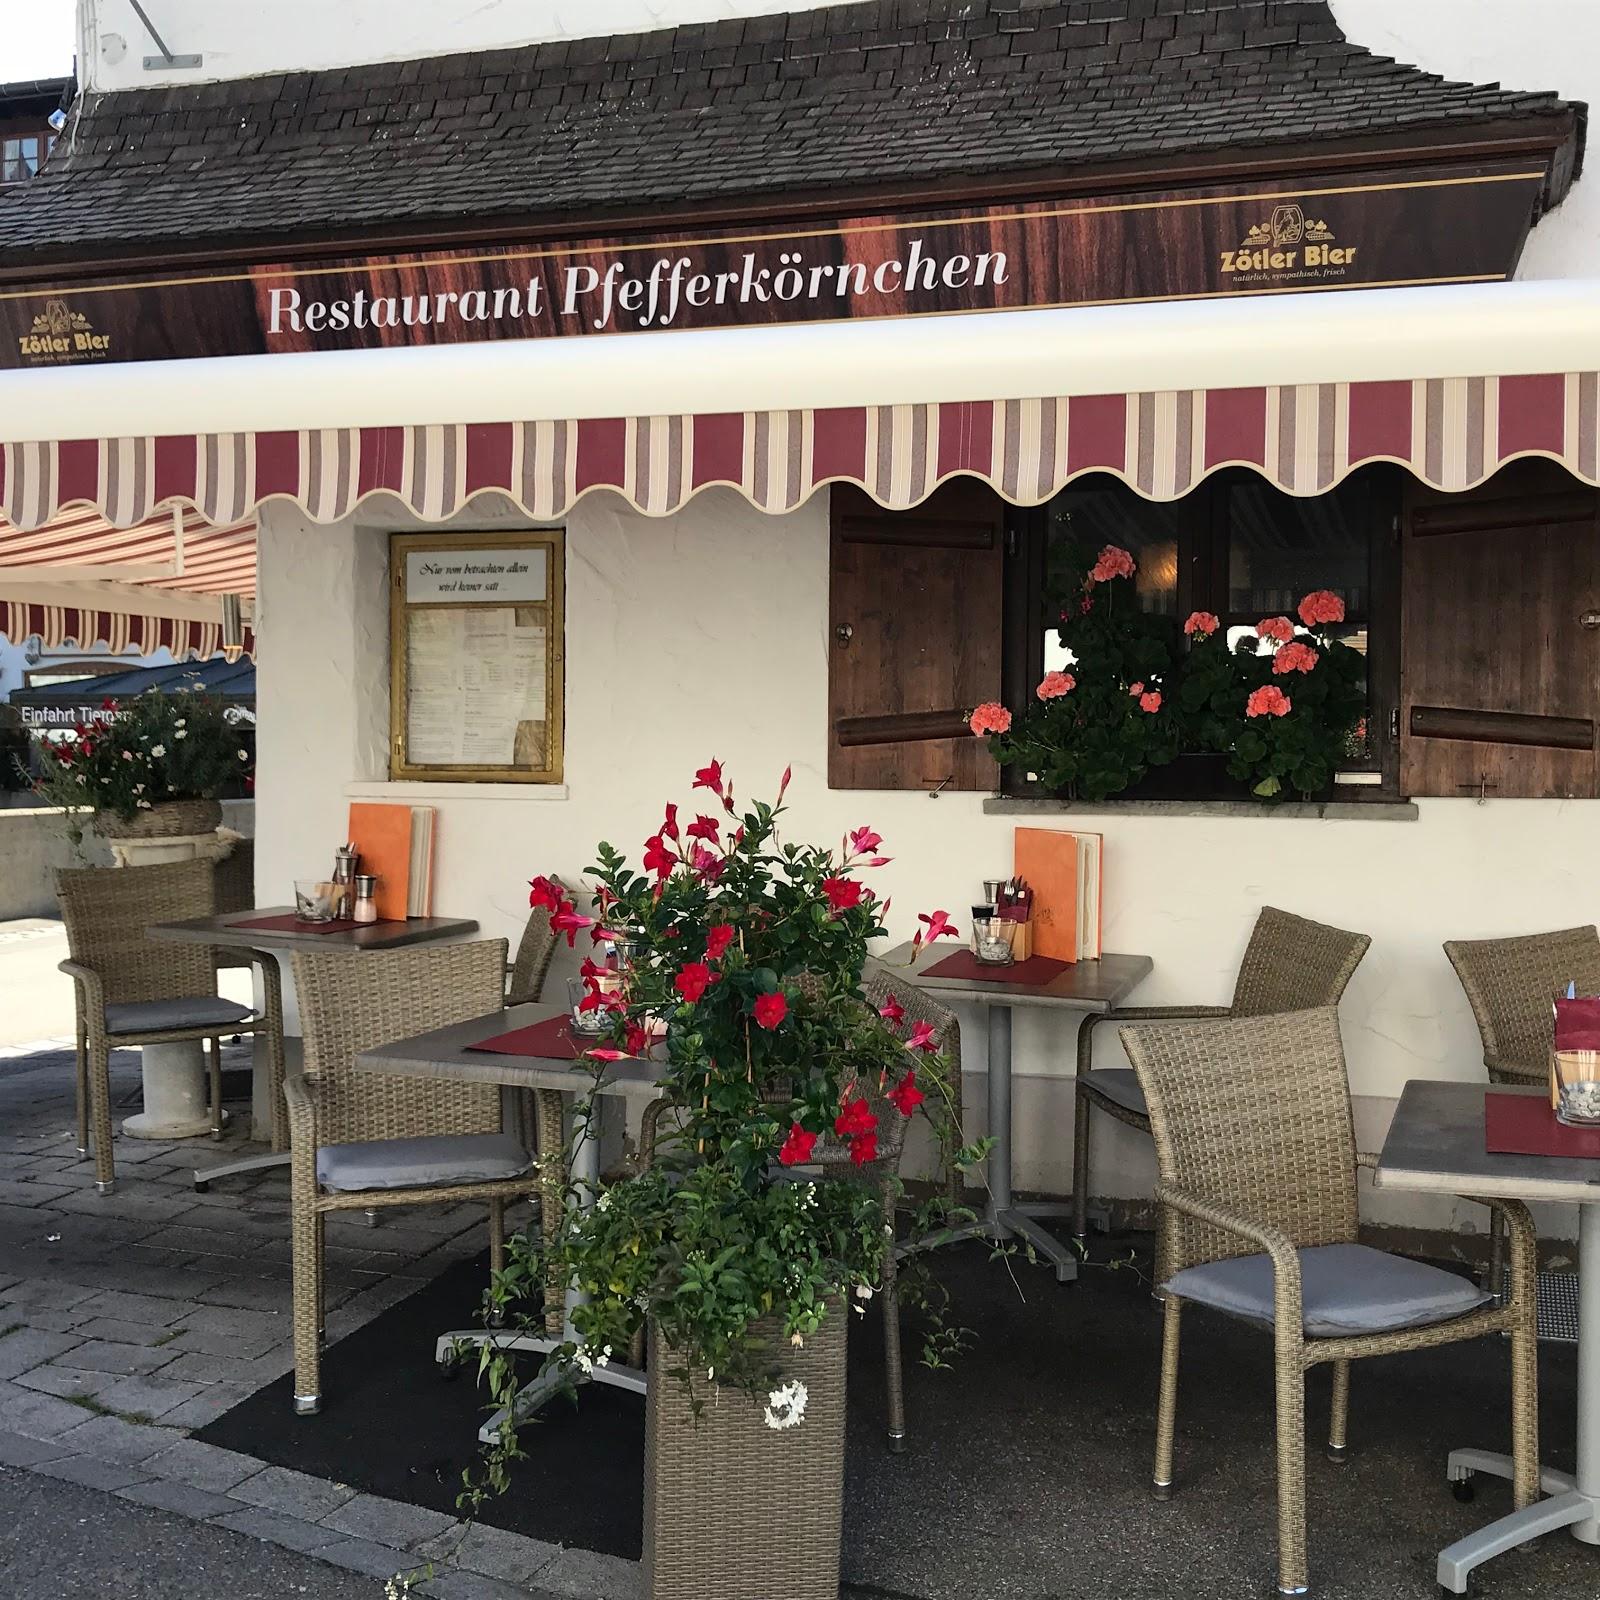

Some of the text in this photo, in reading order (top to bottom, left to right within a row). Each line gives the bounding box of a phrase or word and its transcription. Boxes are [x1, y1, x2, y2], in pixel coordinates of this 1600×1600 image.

[1220, 244, 1356, 272] Zötler Bier
[1232, 267, 1345, 281] natürlich, sympathisch, frisch
[268, 241, 1009, 333] Restaurant Pfefferkörnchen
[19, 332, 109, 354] Zötler Bier
[21, 706, 76, 723] Einfahrt
